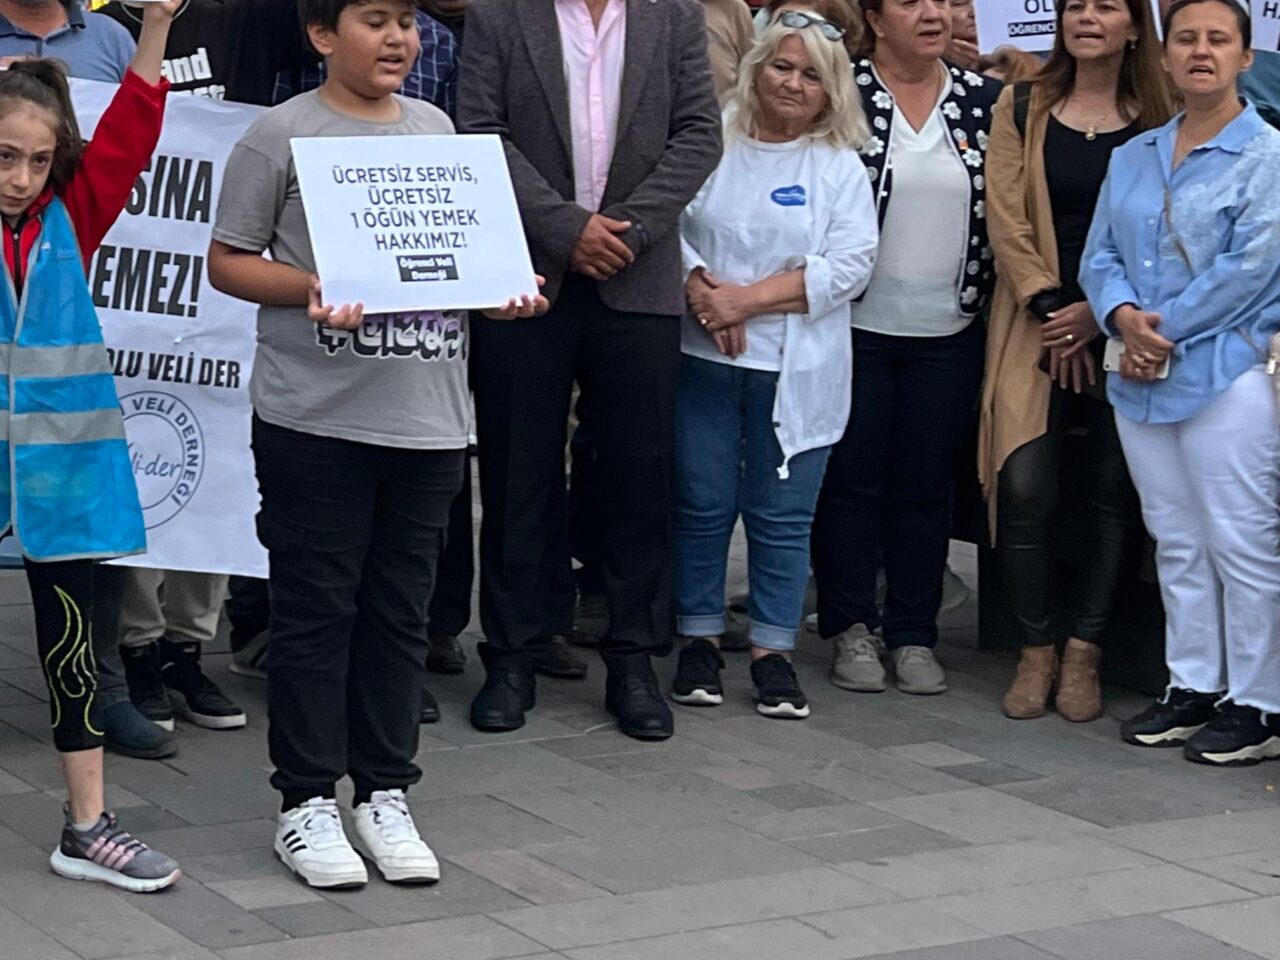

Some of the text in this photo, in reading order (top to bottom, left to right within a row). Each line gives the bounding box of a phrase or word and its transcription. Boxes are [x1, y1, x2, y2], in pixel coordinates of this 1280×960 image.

[332, 163, 478, 184] ÜCRETSİZ SERVİS,
[368, 184, 454, 205] ÜCRETSİZ
[350, 207, 480, 228] 1 ÖĞÜN YEMEK
[375, 231, 468, 250] HAKKIMIZ!
[400, 257, 454, 269] Öğrenci Veli
[412, 269, 448, 280] Derneği
[147, 351, 196, 384] VELİ
[198, 358, 241, 389] DER
[132, 396, 200, 506] VELİ DERNEĞİ
